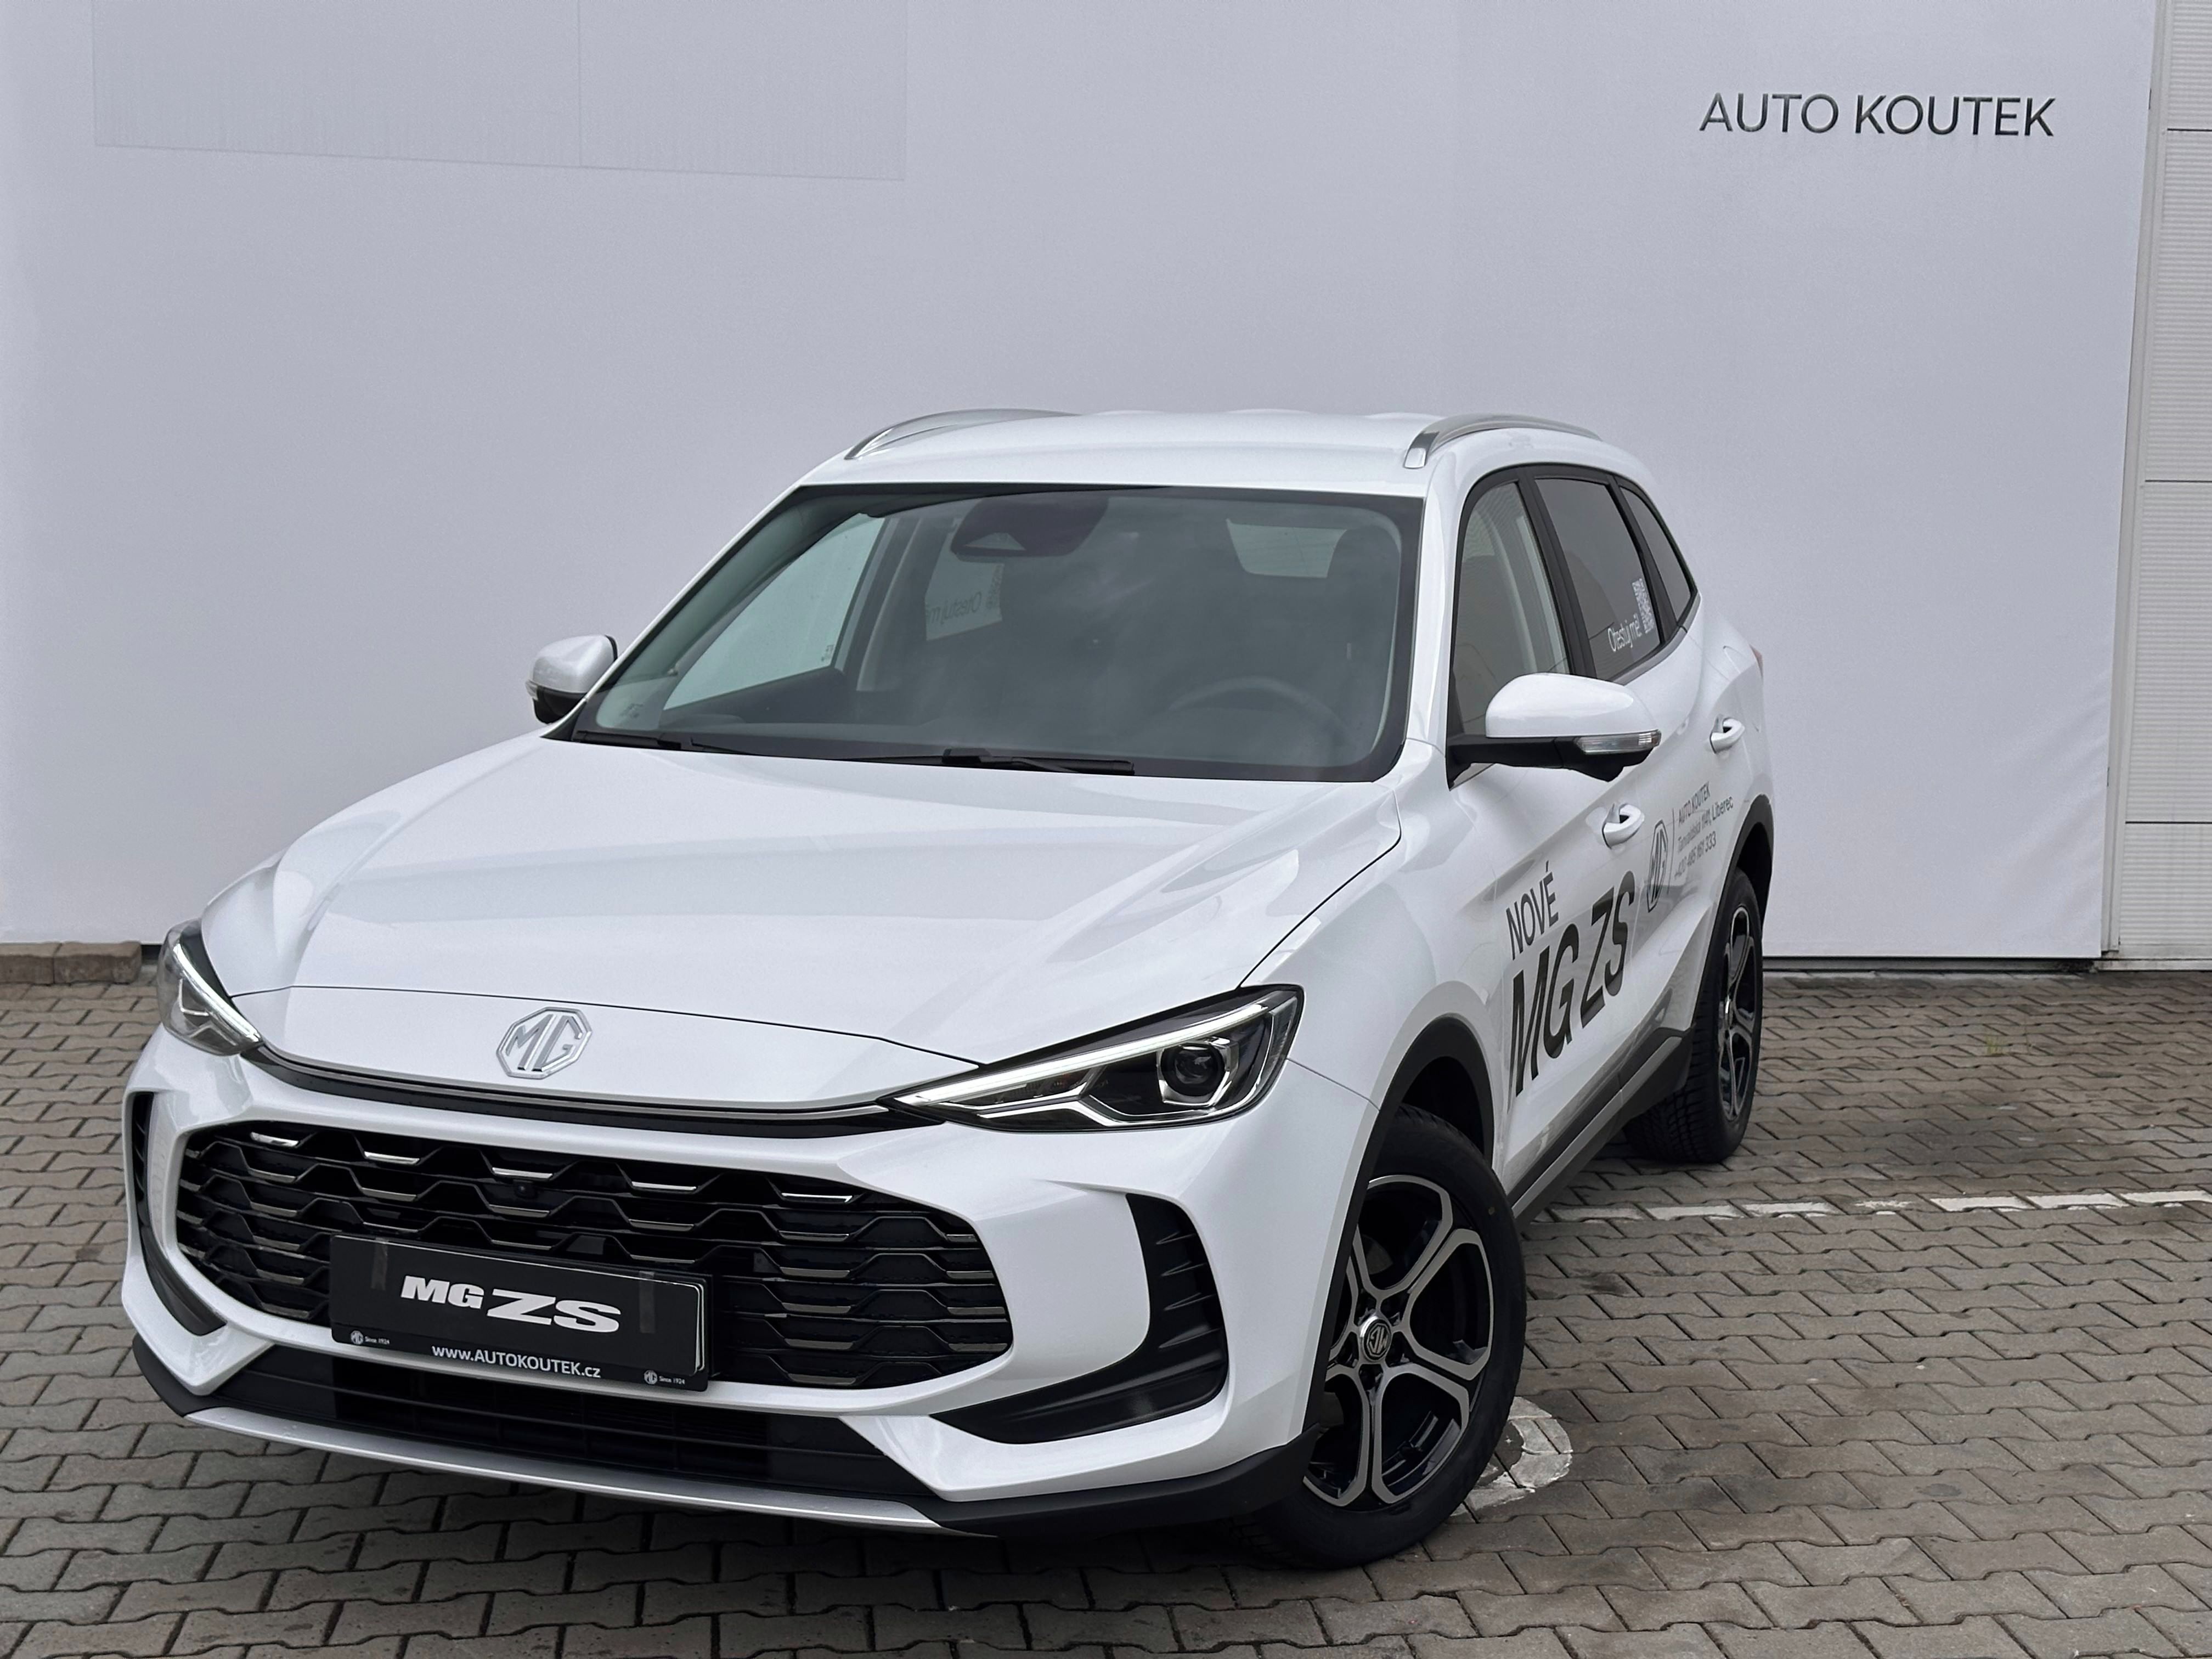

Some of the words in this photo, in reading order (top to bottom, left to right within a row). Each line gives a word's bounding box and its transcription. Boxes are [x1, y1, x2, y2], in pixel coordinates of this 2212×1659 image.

[1700, 92, 1839, 133] AUTO
[1855, 94, 2056, 137] KOUTEK
[1678, 799, 1691, 827] AUTO
[1691, 781, 1711, 811] KOUTEK
[1712, 796, 1734, 821] Liberec
[1705, 830, 1717, 853] 333
[1505, 860, 1559, 961] NOVÉ
[1507, 923, 1579, 1113] MG
[1580, 870, 1635, 1029] ZS
[504, 1013, 584, 1072] MG
[400, 1275, 484, 1310] MG
[487, 1288, 622, 1333] ZS
[432, 1345, 601, 1378] www.AUTOKOUTEK.cz
